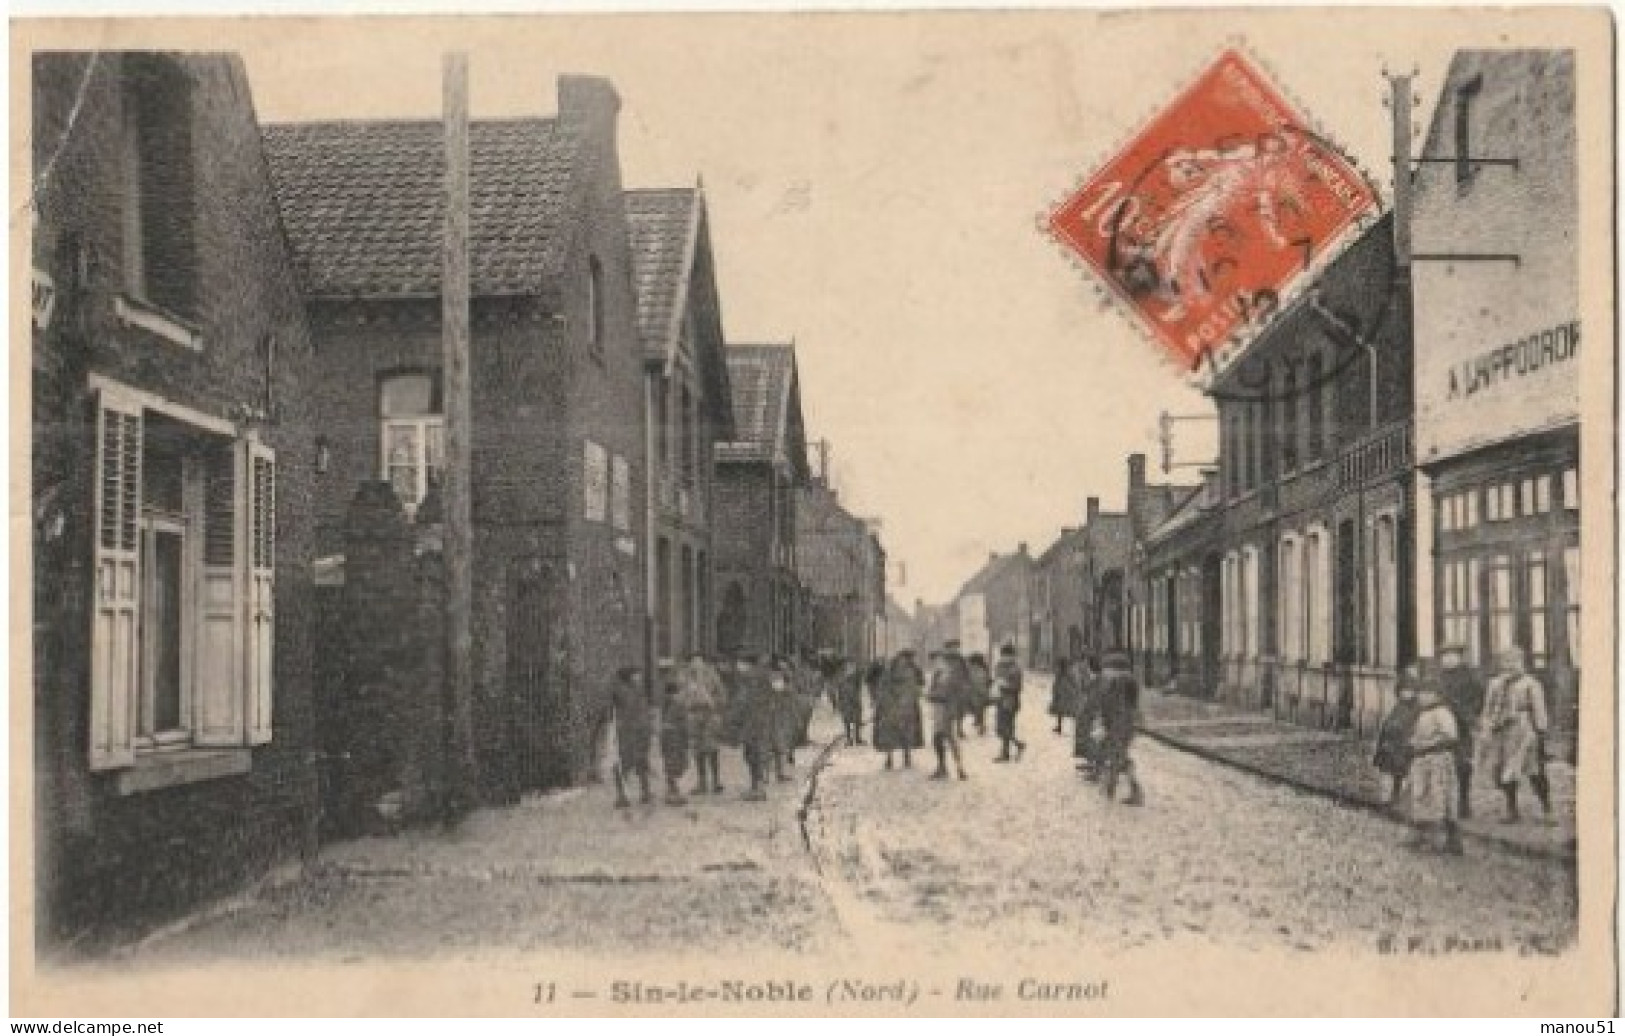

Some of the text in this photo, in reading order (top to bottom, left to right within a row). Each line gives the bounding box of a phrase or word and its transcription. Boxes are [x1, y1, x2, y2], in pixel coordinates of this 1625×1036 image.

[534, 982, 556, 1003] 11
[610, 980, 813, 1003] Sin-le-Noble
[826, 979, 919, 1006] (Nord)
[954, 977, 1002, 1001] Rue
[1017, 977, 1108, 1001] Carnot
